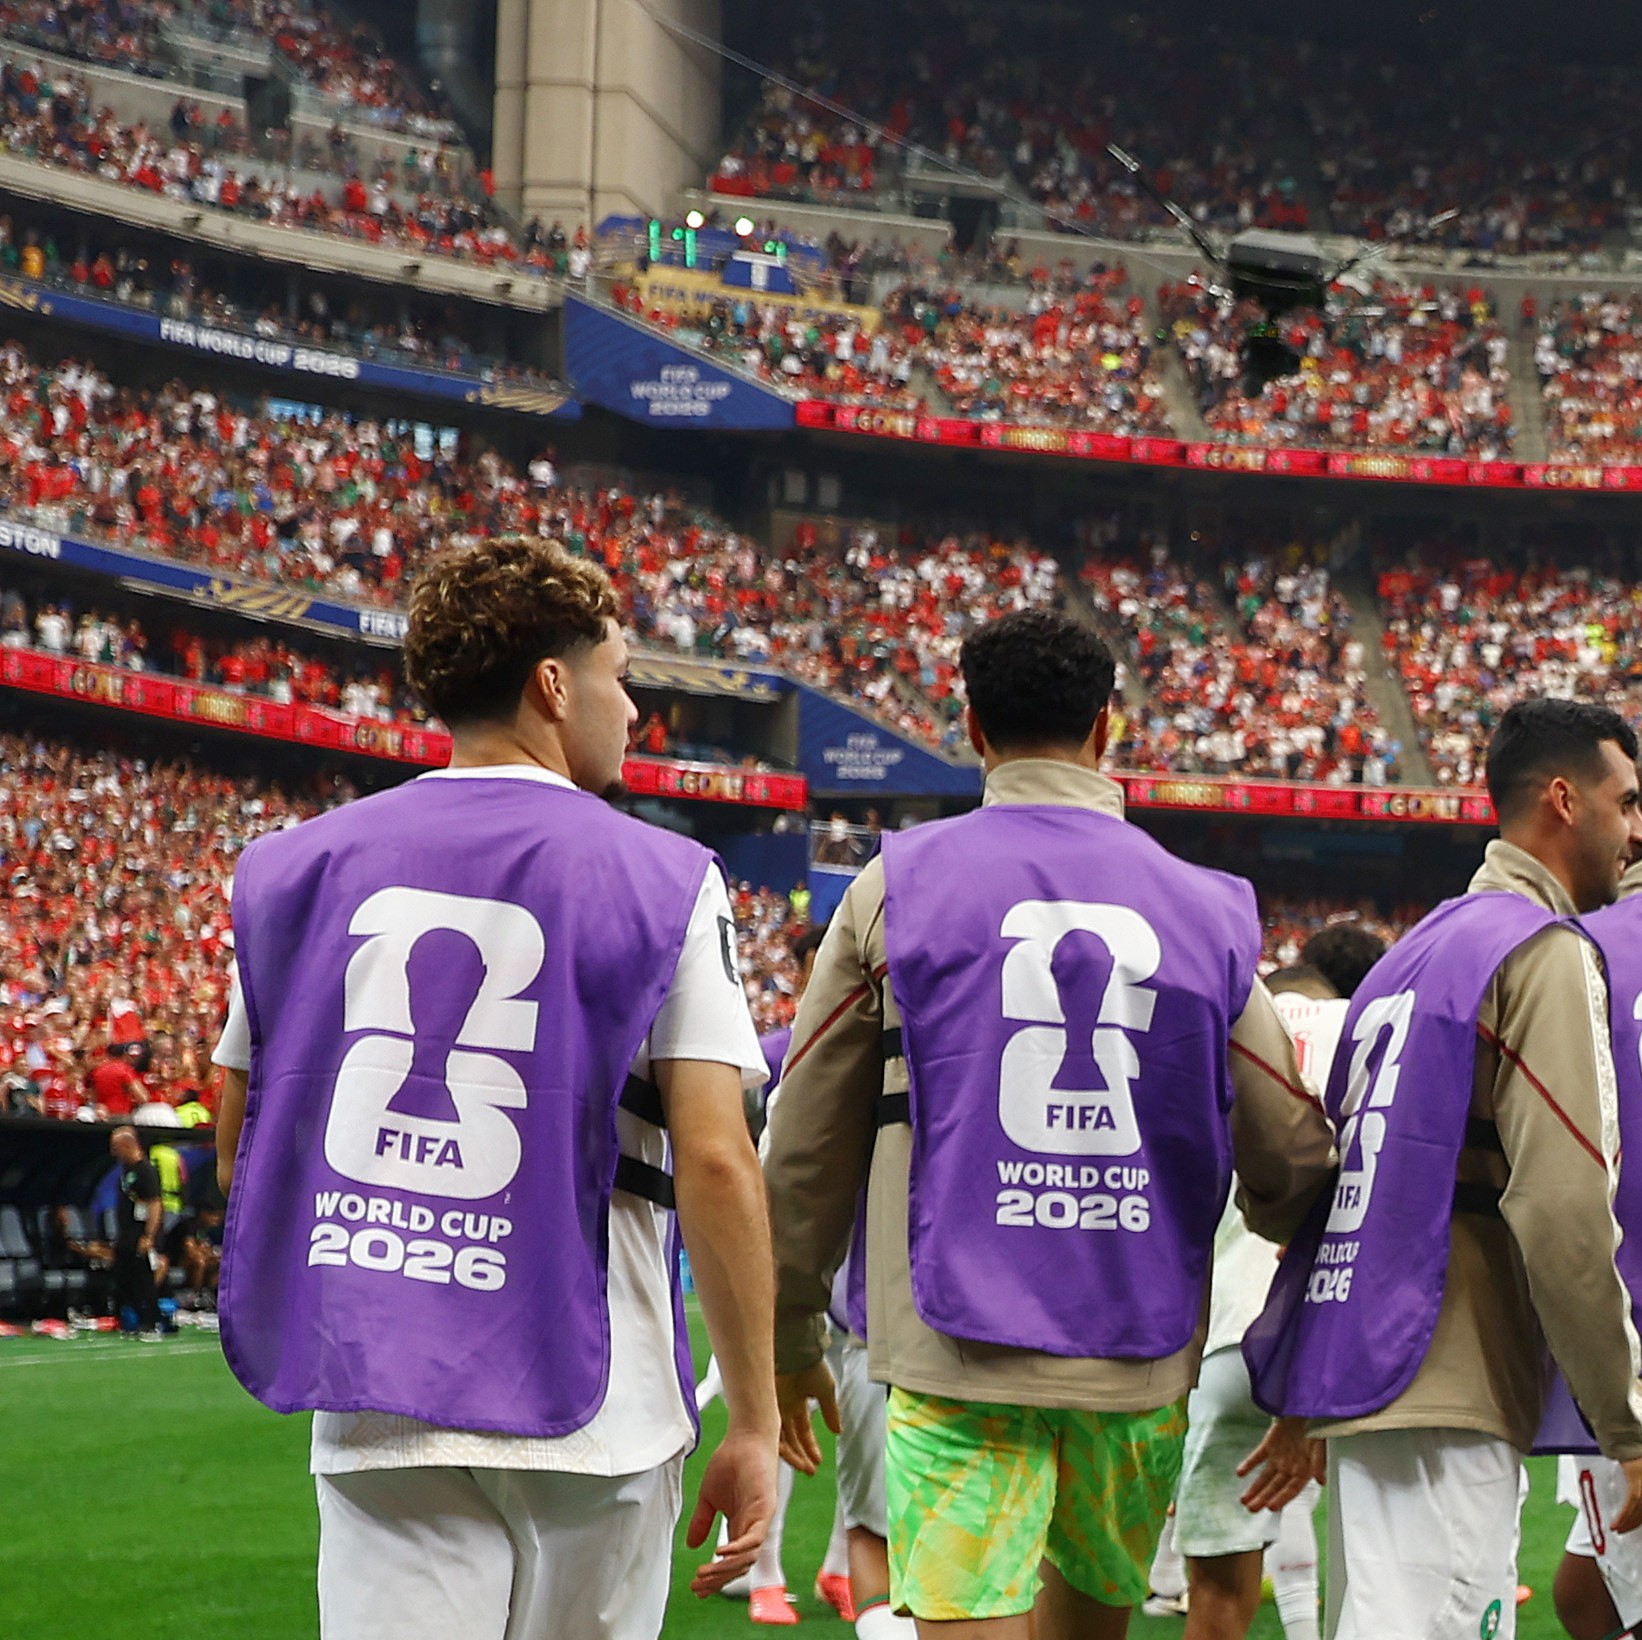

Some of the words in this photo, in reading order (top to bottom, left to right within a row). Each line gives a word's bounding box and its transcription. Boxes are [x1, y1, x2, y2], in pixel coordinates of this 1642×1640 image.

[160, 318, 196, 346] FIFA
[197, 326, 255, 359] WORLD
[255, 339, 293, 366] CUP
[293, 348, 360, 379] 2026
[1046, 1105, 1116, 1131] FIFA
[374, 1128, 464, 1170] FIFA
[997, 1161, 1099, 1190] WORLD
[1105, 1165, 1150, 1192] CUP
[1337, 1185, 1361, 1209] IFA
[315, 1191, 435, 1234] WORLD
[440, 1210, 513, 1243] CUP
[996, 1189, 1150, 1233] 2026
[308, 1222, 507, 1292] 2026
